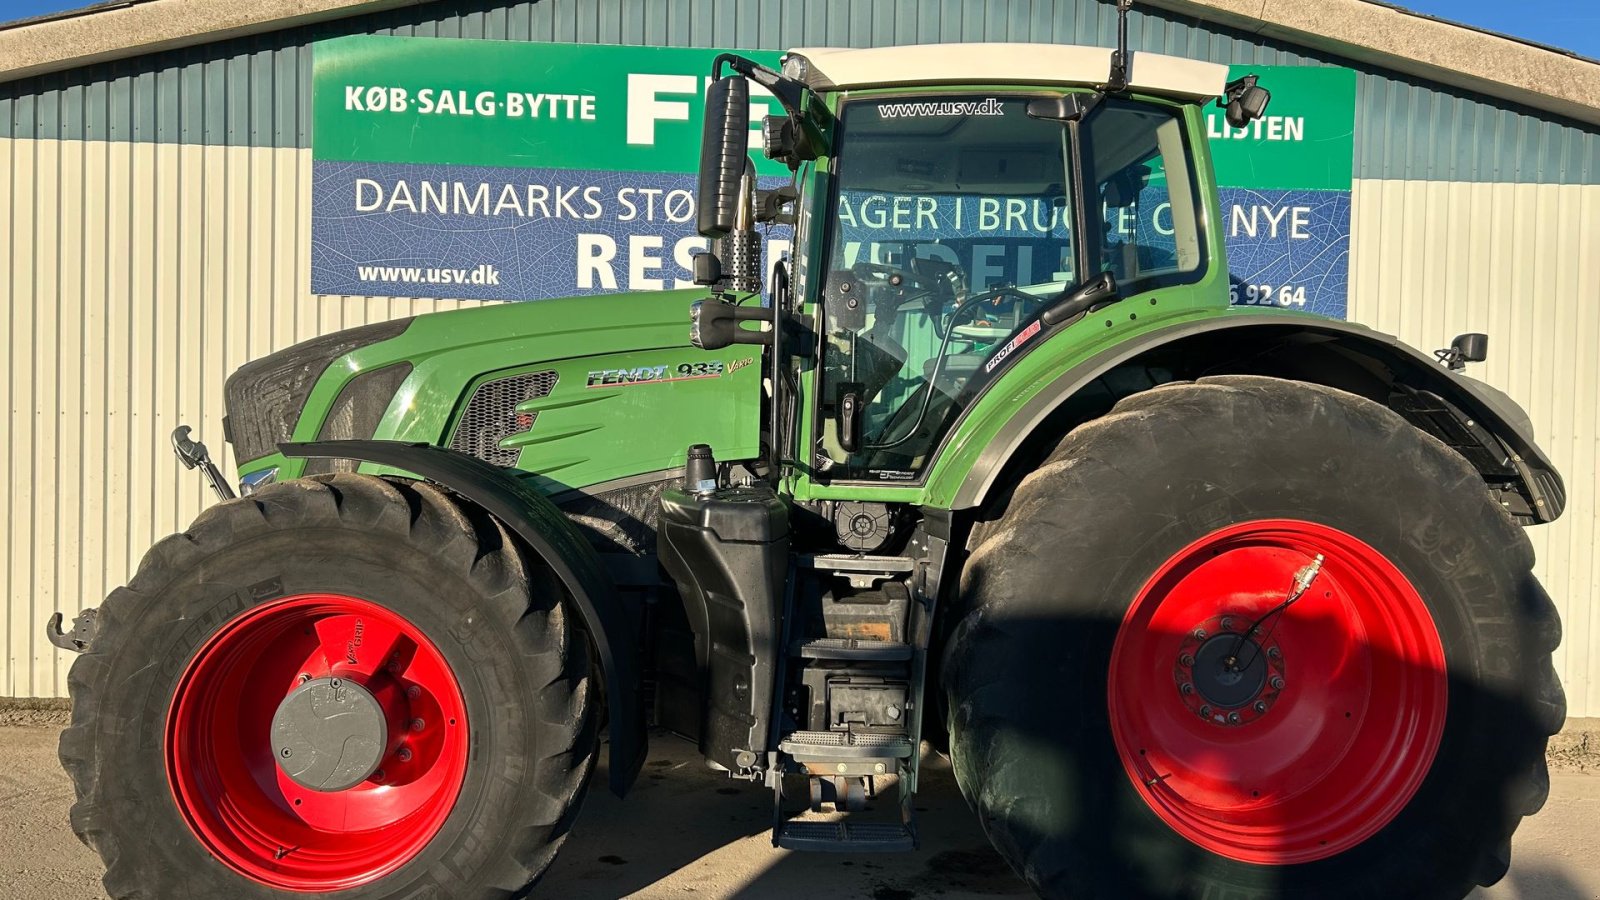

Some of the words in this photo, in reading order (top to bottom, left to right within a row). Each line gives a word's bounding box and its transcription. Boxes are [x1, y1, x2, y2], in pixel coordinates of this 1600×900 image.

[878, 98, 1004, 118] www.usv.dk
[355, 178, 602, 220] DANMARKS
[838, 195, 938, 230] AGER
[956, 197, 962, 230] I
[1231, 204, 1311, 239] NYE
[358, 264, 499, 286] www.usv.dk
[1246, 284, 1272, 305] 92
[1279, 285, 1307, 306] 64
[586, 365, 669, 386] FENDT
[353, 619, 364, 647] GRIP
